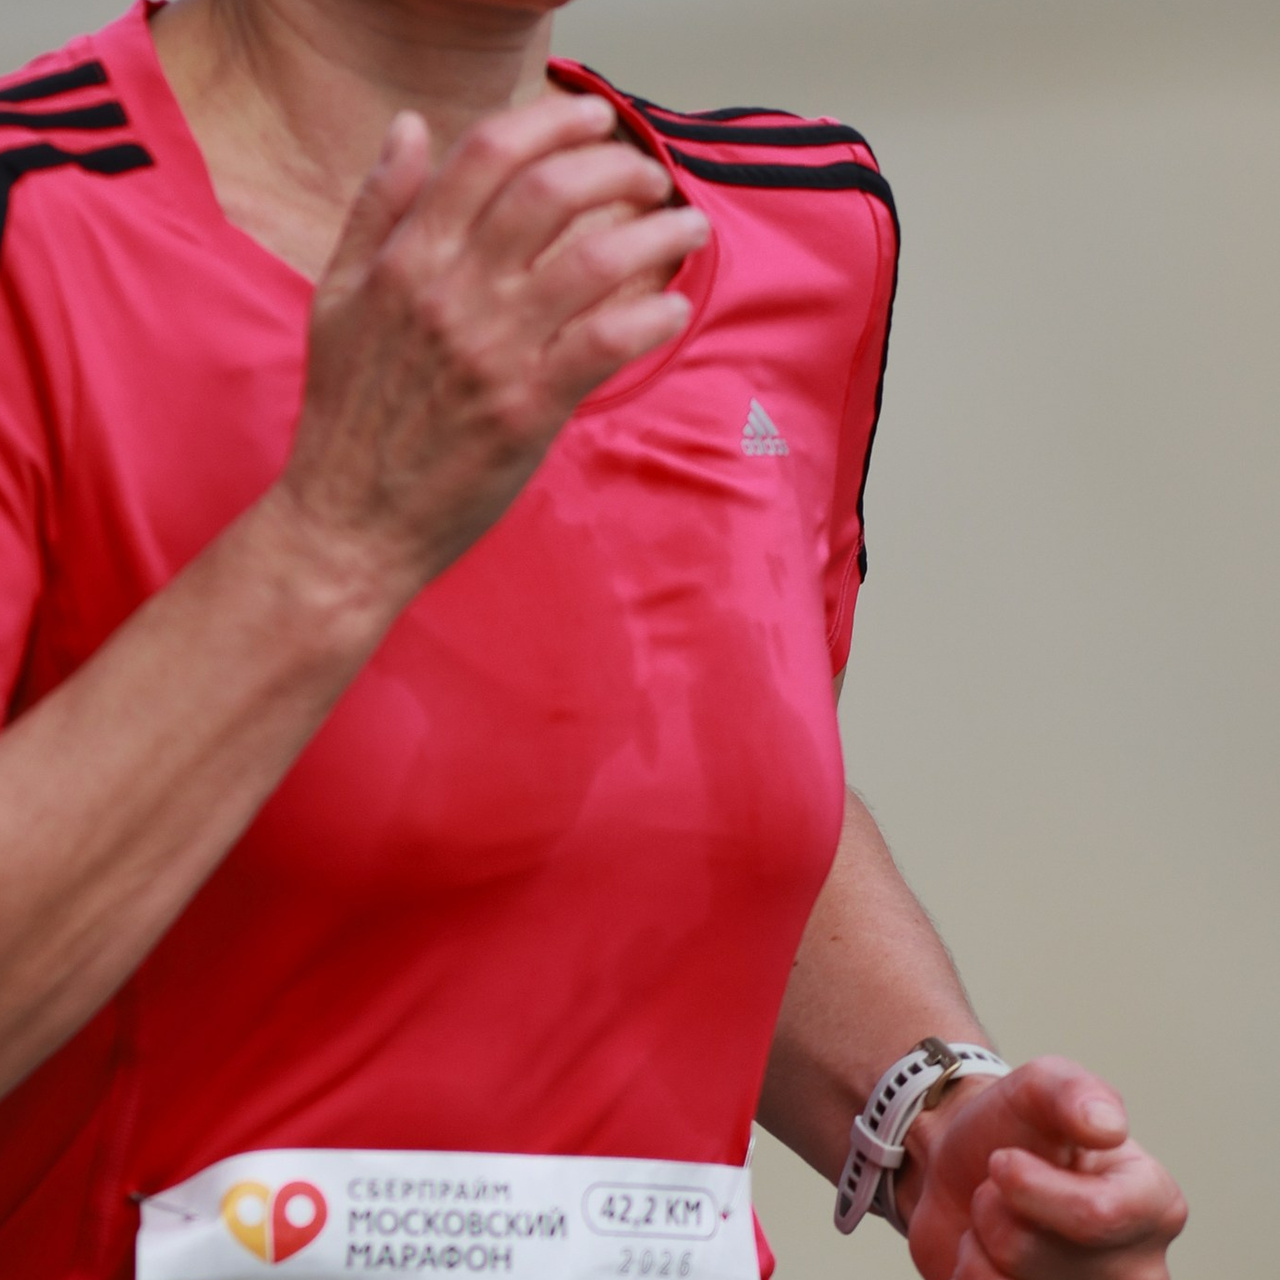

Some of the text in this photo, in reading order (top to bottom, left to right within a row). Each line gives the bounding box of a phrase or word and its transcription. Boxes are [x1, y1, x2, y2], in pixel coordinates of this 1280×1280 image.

[346, 1176, 511, 1202] СБЕРПРАЙМ
[348, 1206, 567, 1238] МОСКОВСКИЙ
[600, 1193, 702, 1227] 42,2 КМ
[345, 1243, 512, 1272] МАРАФОН
[618, 1247, 693, 1279] 2026
